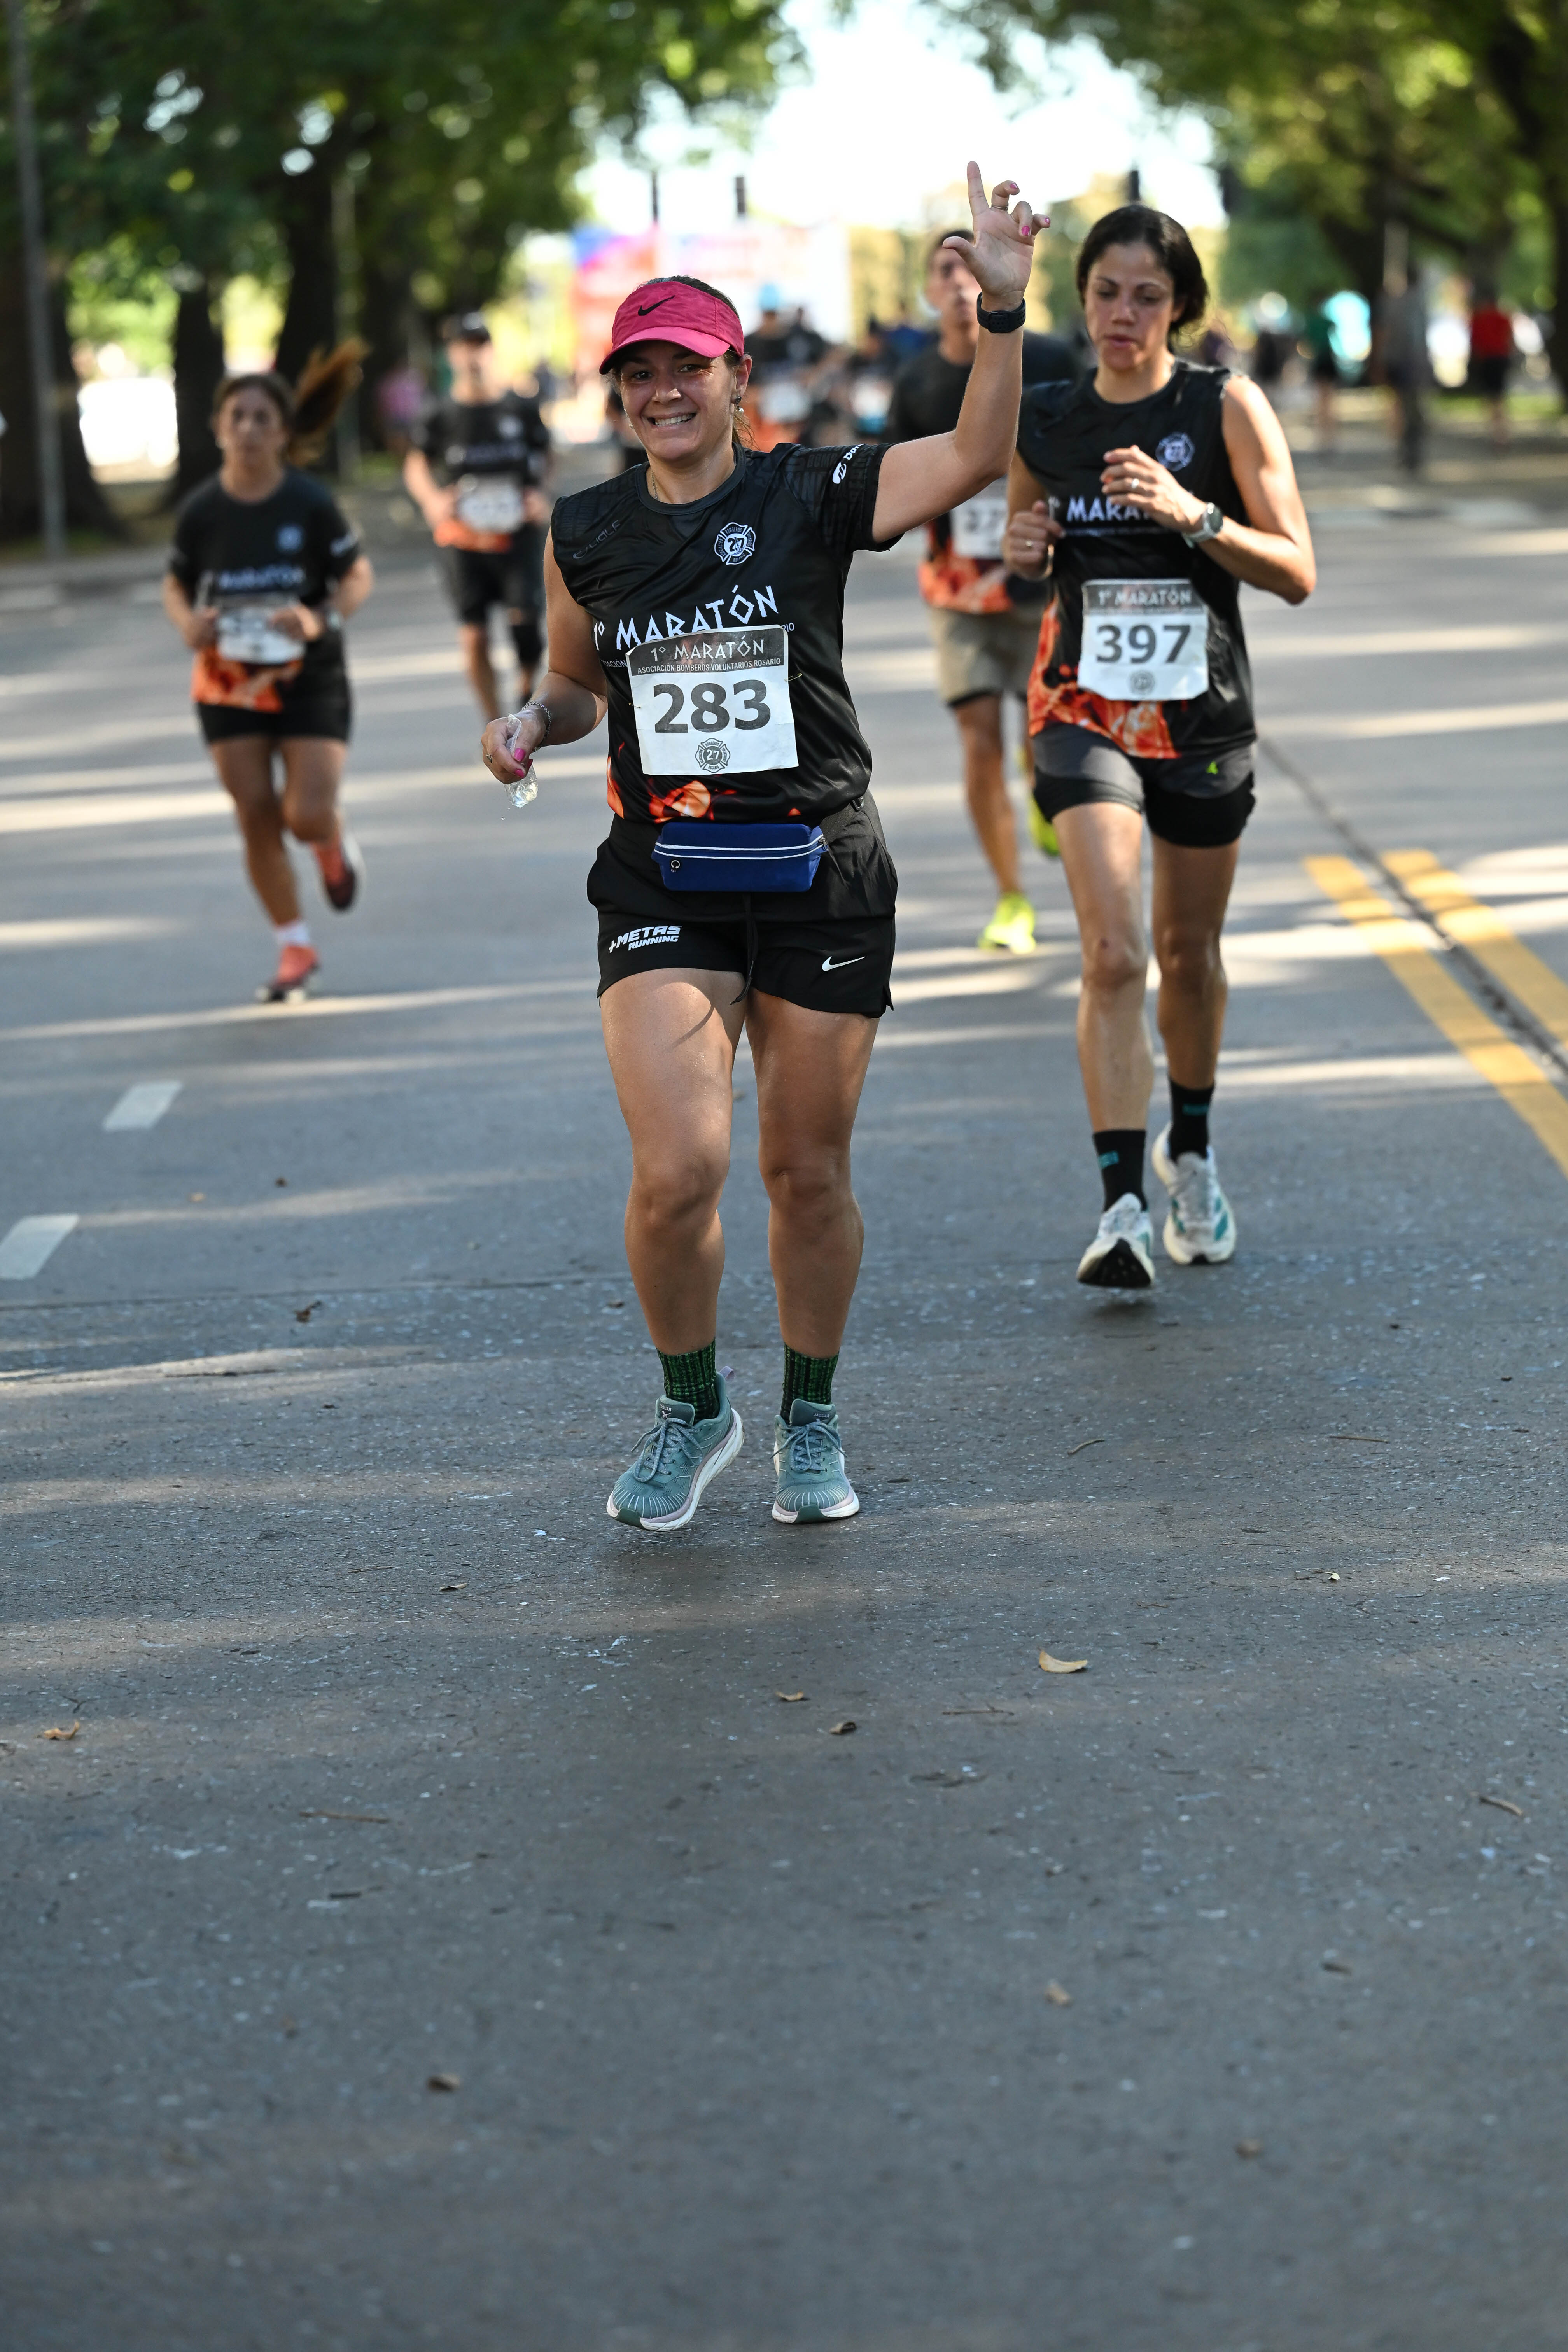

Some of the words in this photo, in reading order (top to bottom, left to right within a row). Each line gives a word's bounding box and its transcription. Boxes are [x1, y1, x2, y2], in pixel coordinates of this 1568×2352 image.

[728, 538, 744, 552] 27
[617, 585, 779, 650] MARATÓN
[674, 635, 764, 660] MARATÓN
[1097, 625, 1191, 664] 397
[638, 663, 675, 674] ASOCIACIÓN
[711, 661, 752, 670] VOLUNTARIOS
[754, 658, 781, 666] ROSARIO
[654, 679, 771, 733] 283
[706, 749, 719, 761] 27
[628, 935, 679, 951] RUNNING
